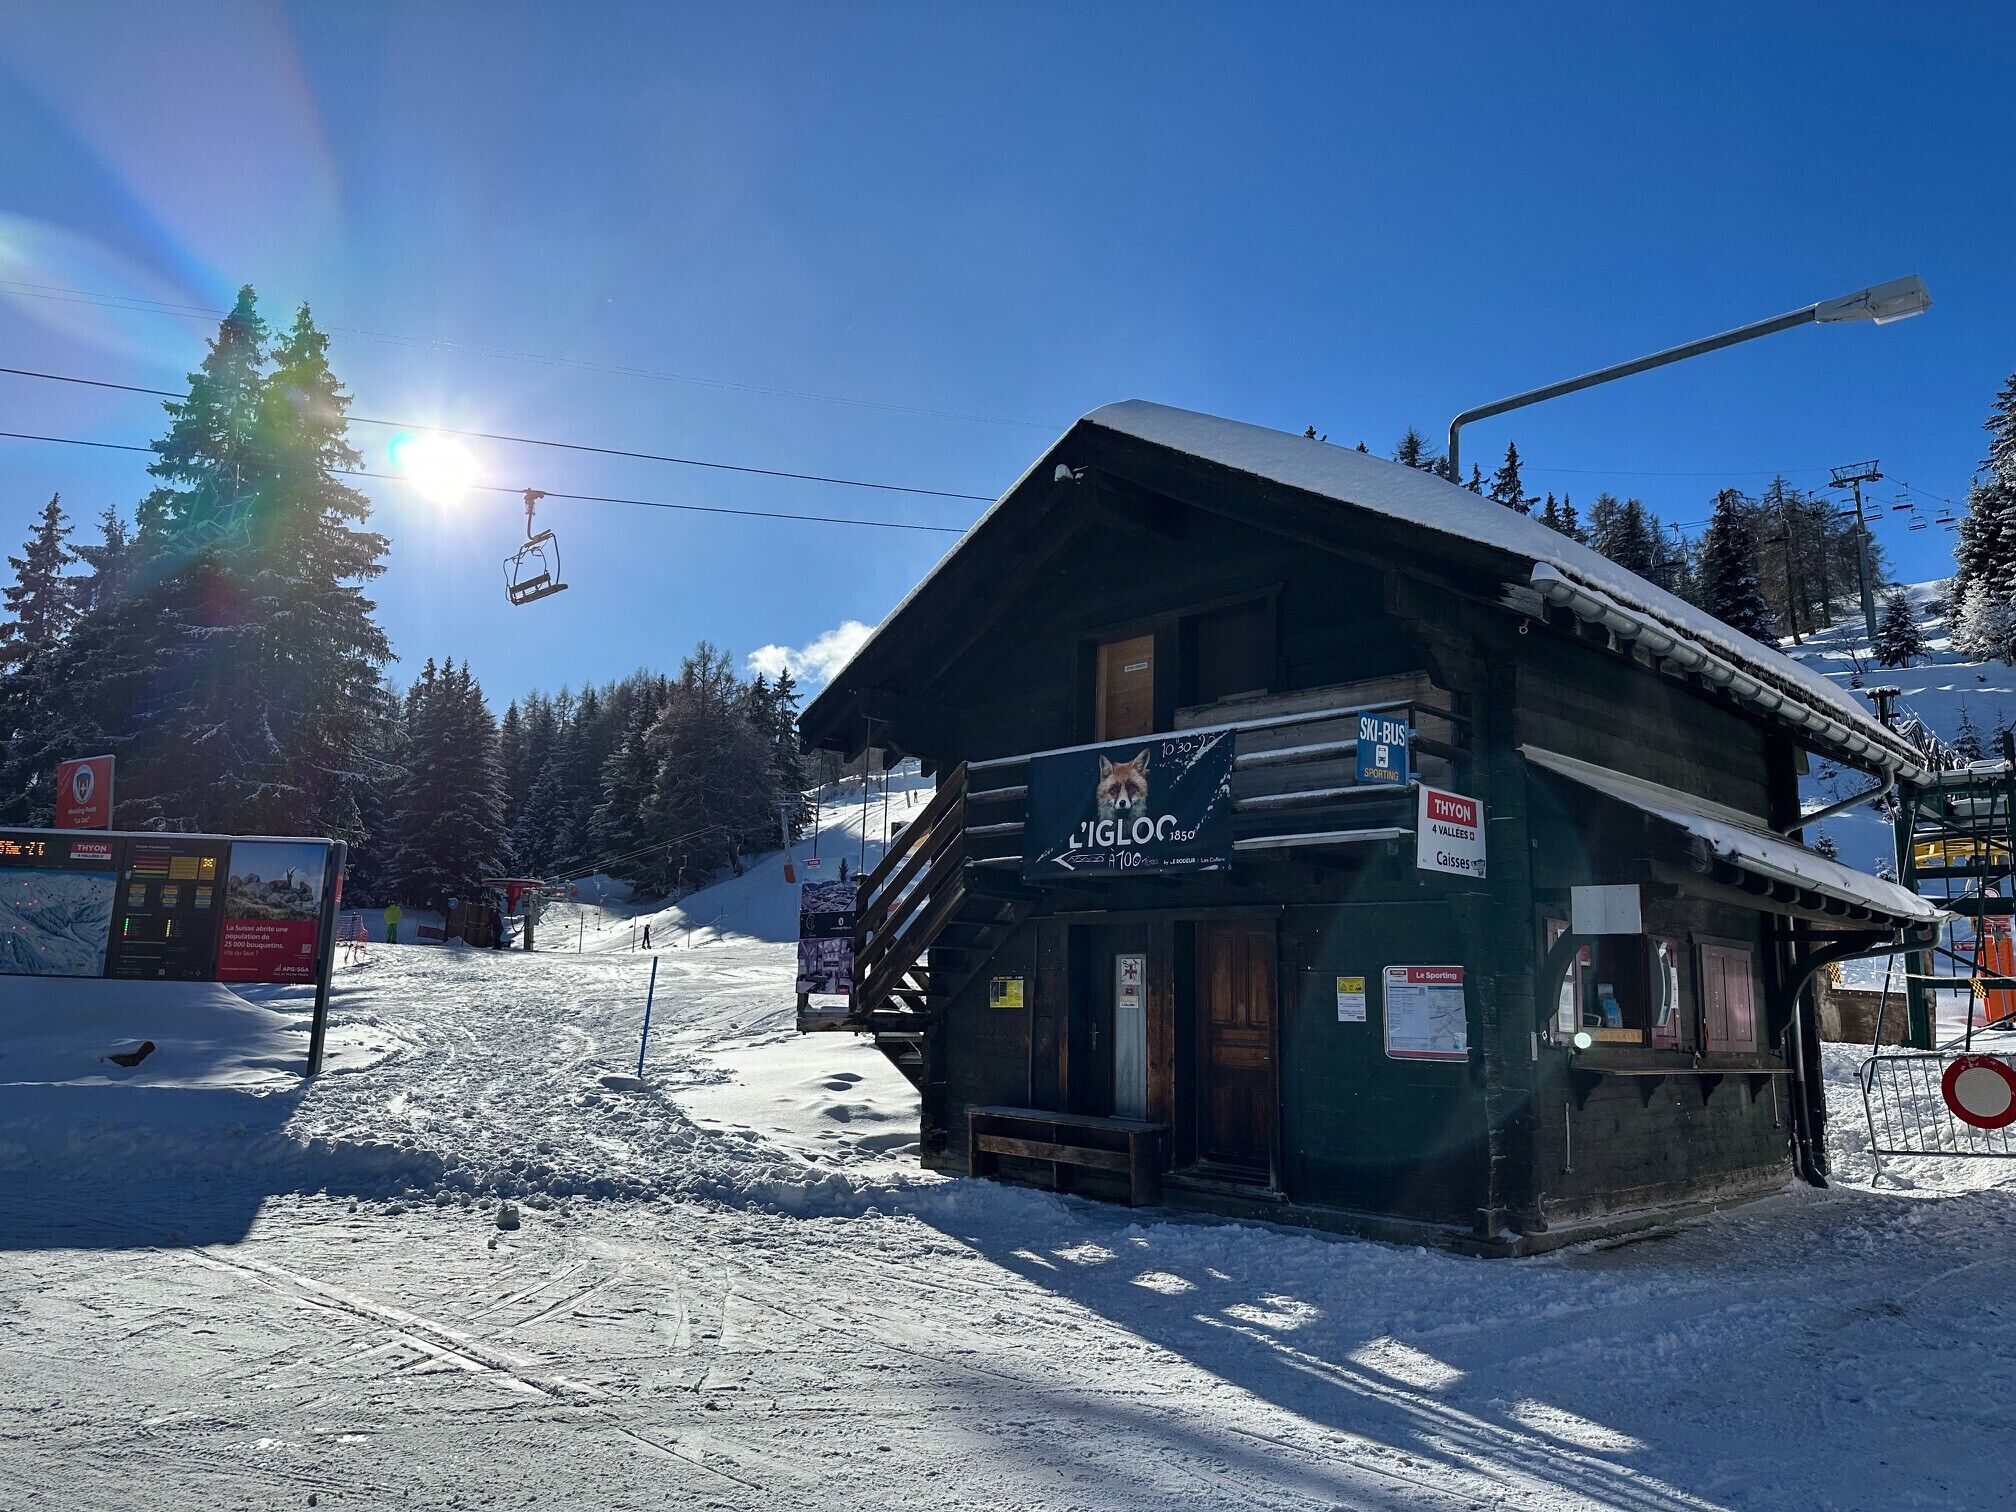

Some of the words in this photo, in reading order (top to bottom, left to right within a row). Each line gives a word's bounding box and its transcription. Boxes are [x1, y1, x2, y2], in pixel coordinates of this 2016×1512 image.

[1359, 716, 1406, 747] SKI-BUS
[1363, 767, 1399, 781] SPORTING
[1434, 799, 1471, 823] THYON
[1169, 830, 1195, 842] 1850
[1432, 824, 1437, 834] 4
[1438, 825, 1469, 840] VALLÉES
[77, 844, 107, 852] THYON
[1115, 850, 1142, 870] 100
[1436, 850, 1470, 869] Caisses
[246, 941, 285, 949] bouquetins.
[1416, 971, 1425, 979] Le
[1426, 971, 1457, 980] Sporting
